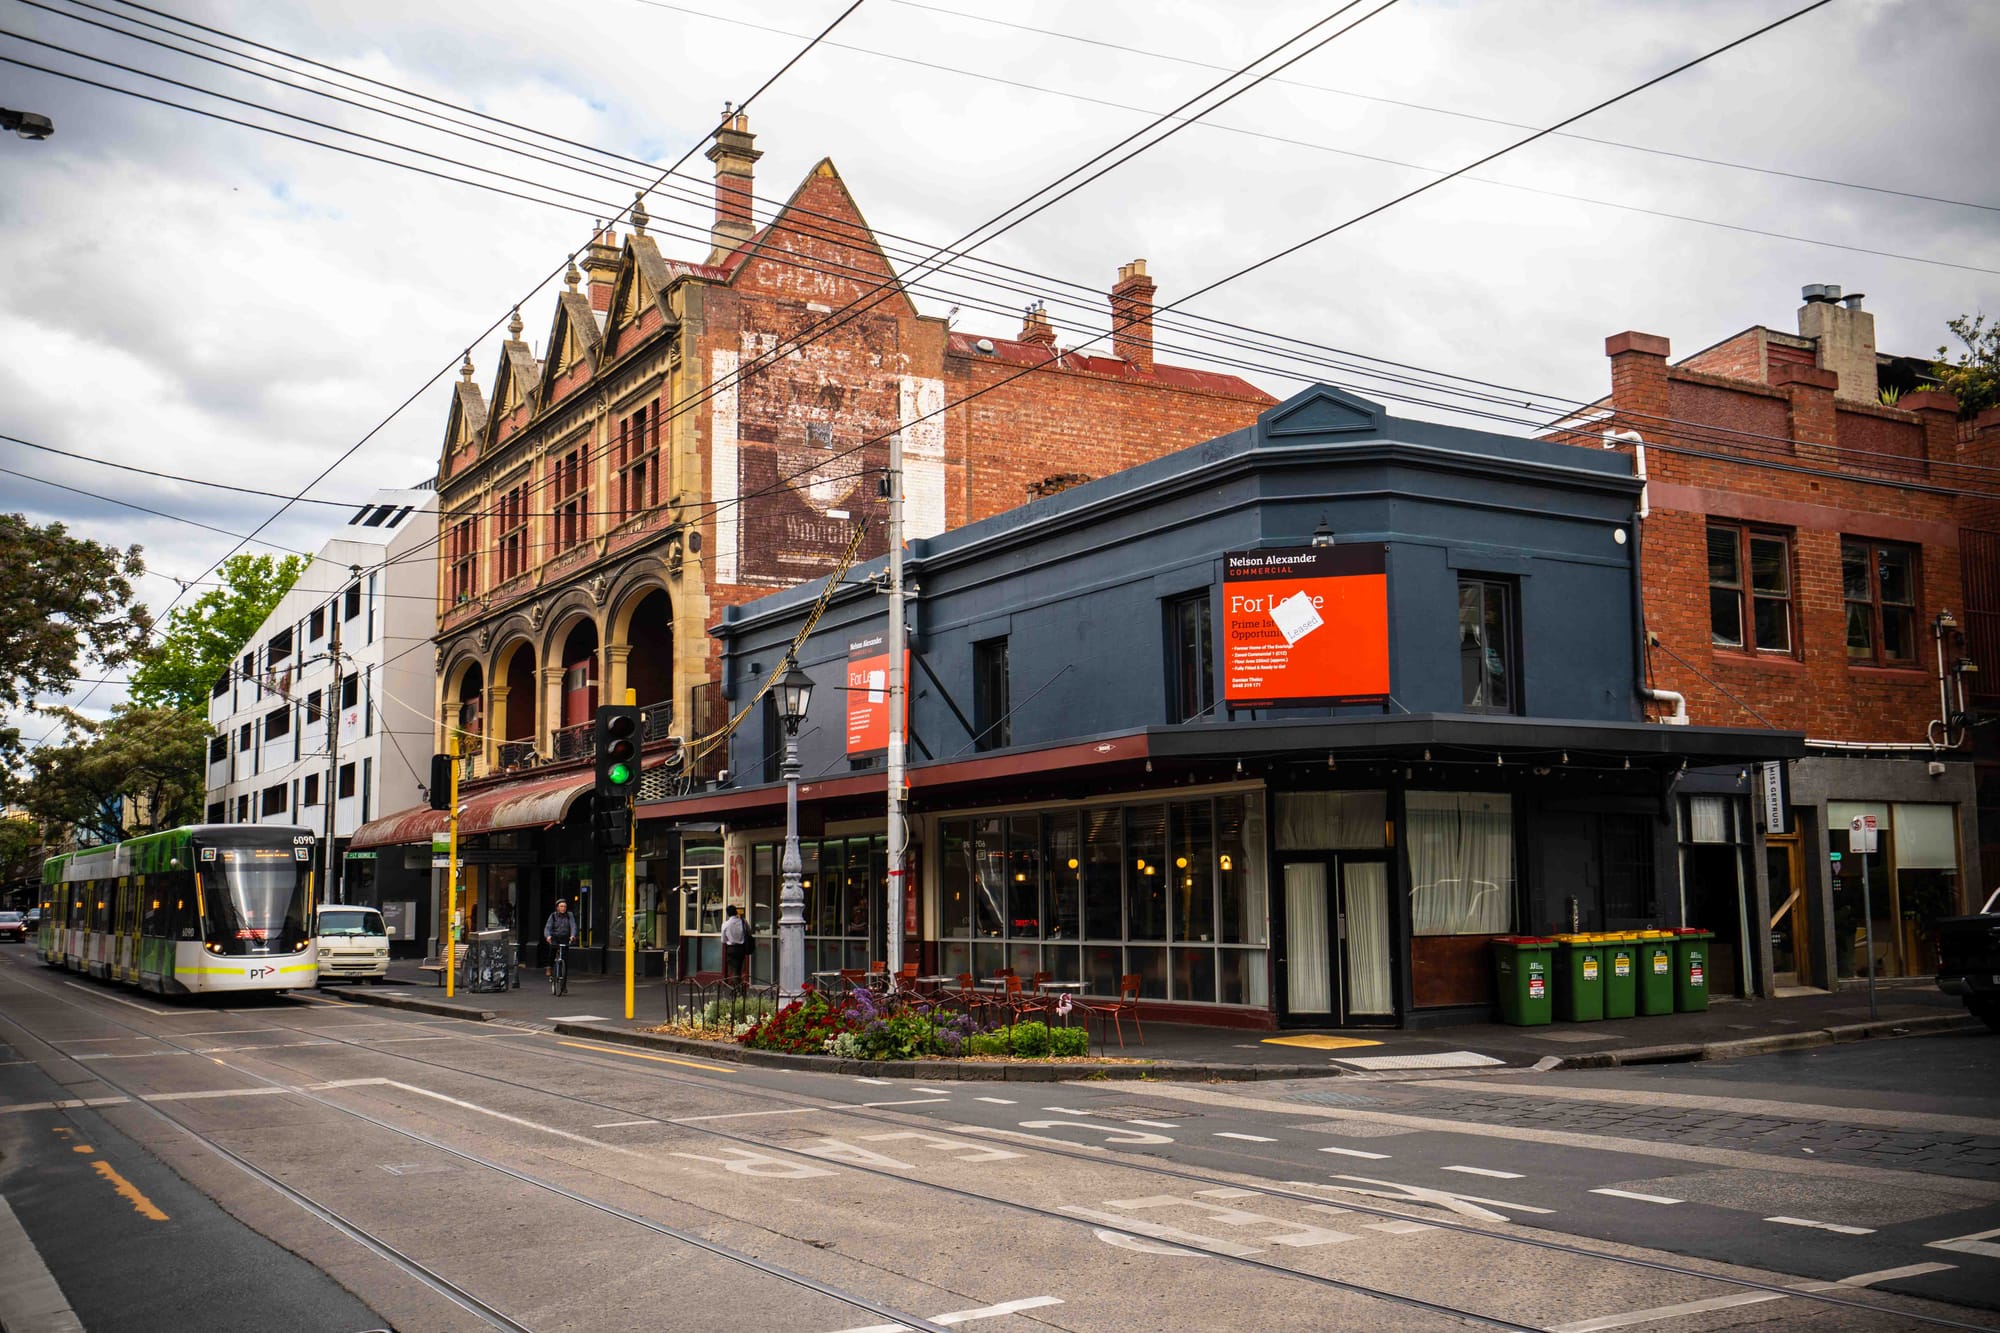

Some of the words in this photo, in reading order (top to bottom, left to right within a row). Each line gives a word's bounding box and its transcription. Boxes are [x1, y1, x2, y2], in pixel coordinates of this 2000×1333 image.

[1229, 557, 1264, 567] Nelson
[1265, 554, 1317, 565] Alexander
[1229, 566, 1293, 576] COMMERCIAL
[1231, 595, 1264, 613] For
[1231, 621, 1260, 629] Prime
[1287, 616, 1319, 640] Leased
[850, 672, 862, 686] For
[1770, 787, 1779, 828] GERTRUDE
[293, 836, 315, 845] 6090
